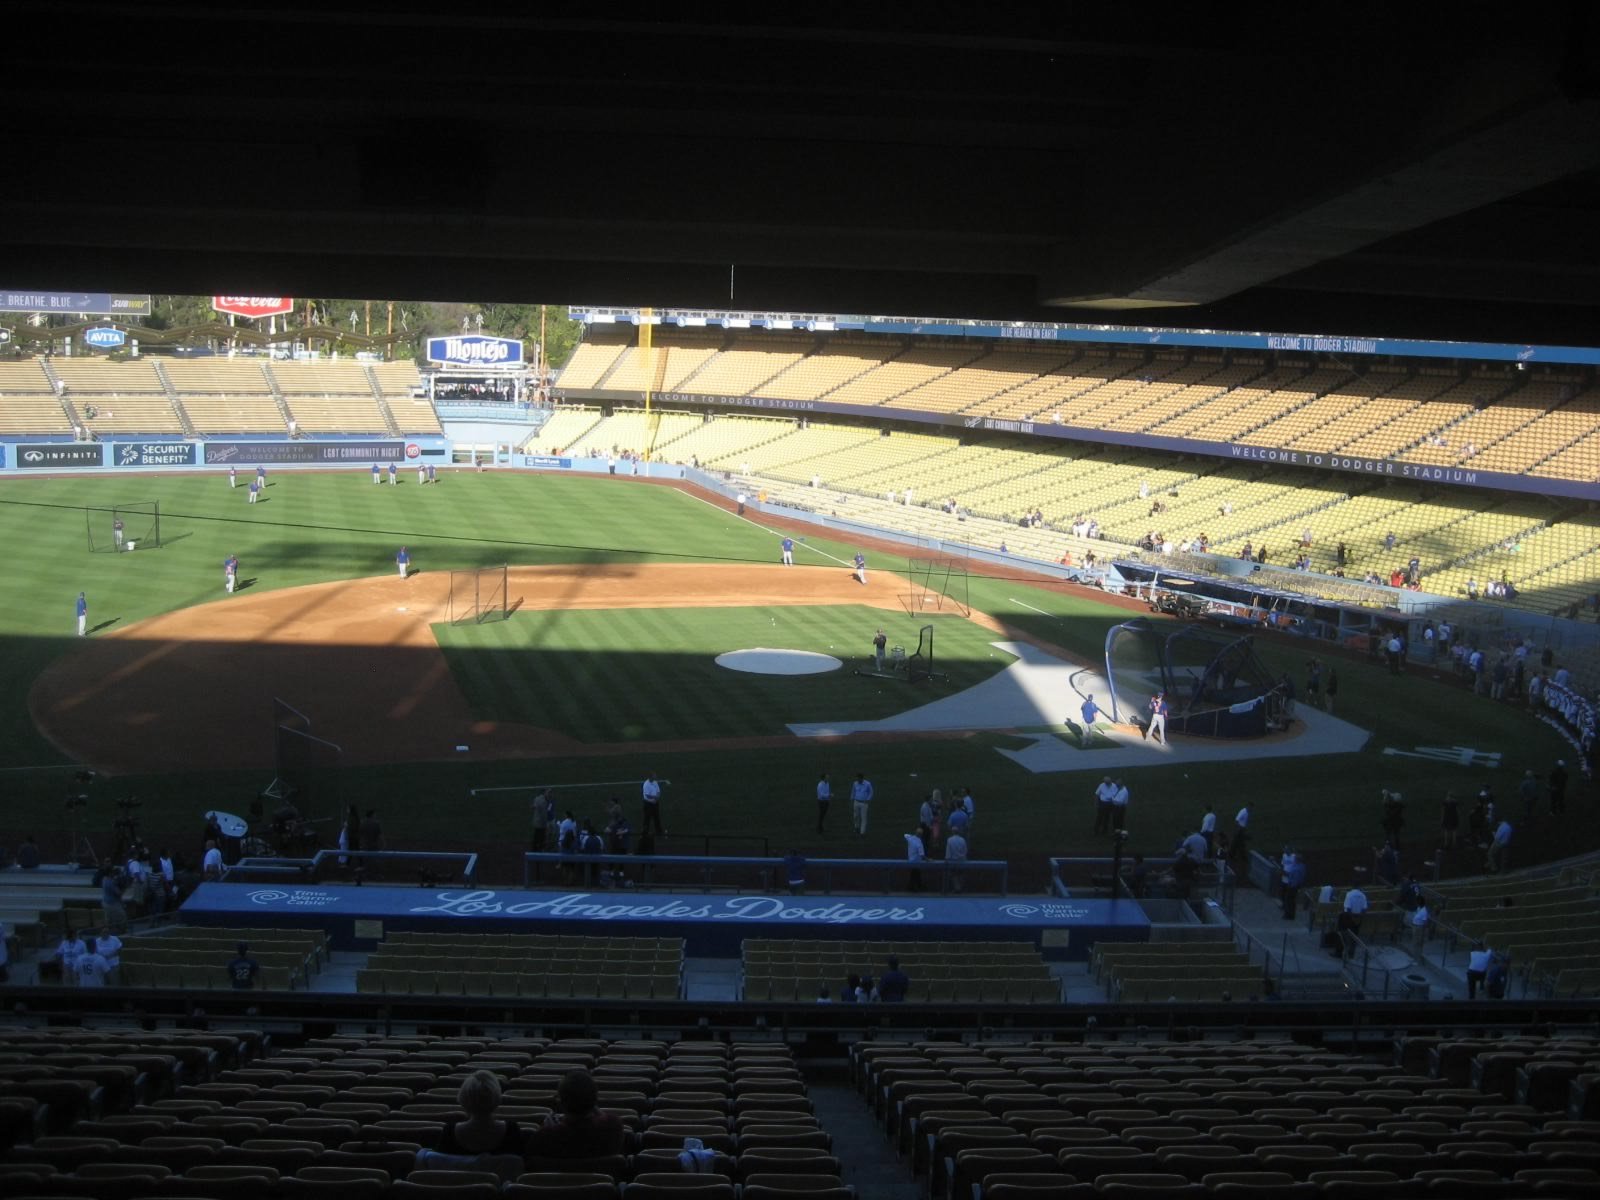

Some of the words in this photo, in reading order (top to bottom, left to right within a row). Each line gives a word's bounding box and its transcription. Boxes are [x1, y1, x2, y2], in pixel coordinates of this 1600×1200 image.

[112, 299, 148, 309] SUBWAY
[91, 332, 120, 342] AVITA
[1042, 329, 1057, 339] EARTH
[445, 339, 508, 362] Montejo
[1267, 336, 1300, 349] WELCOME
[1303, 338, 1311, 349] TO
[1314, 338, 1341, 351] DODGER
[1344, 340, 1375, 353] STADIUM
[642, 393, 695, 402] WELCOME
[722, 397, 764, 406] DODGER
[770, 400, 814, 409] STADIUM
[142, 445, 190, 454] SECURITY
[323, 448, 339, 458] LGBT
[341, 448, 379, 458] COMMUNITY
[381, 447, 400, 457] NIGHT
[1232, 447, 1297, 463] WELCOME
[1306, 454, 1322, 465] TO
[1331, 458, 1393, 473] DODGER
[1403, 466, 1476, 483] STADIUM
[410, 891, 504, 917] Los
[506, 894, 712, 920] Angeles
[712, 897, 924, 923] Dodgers
